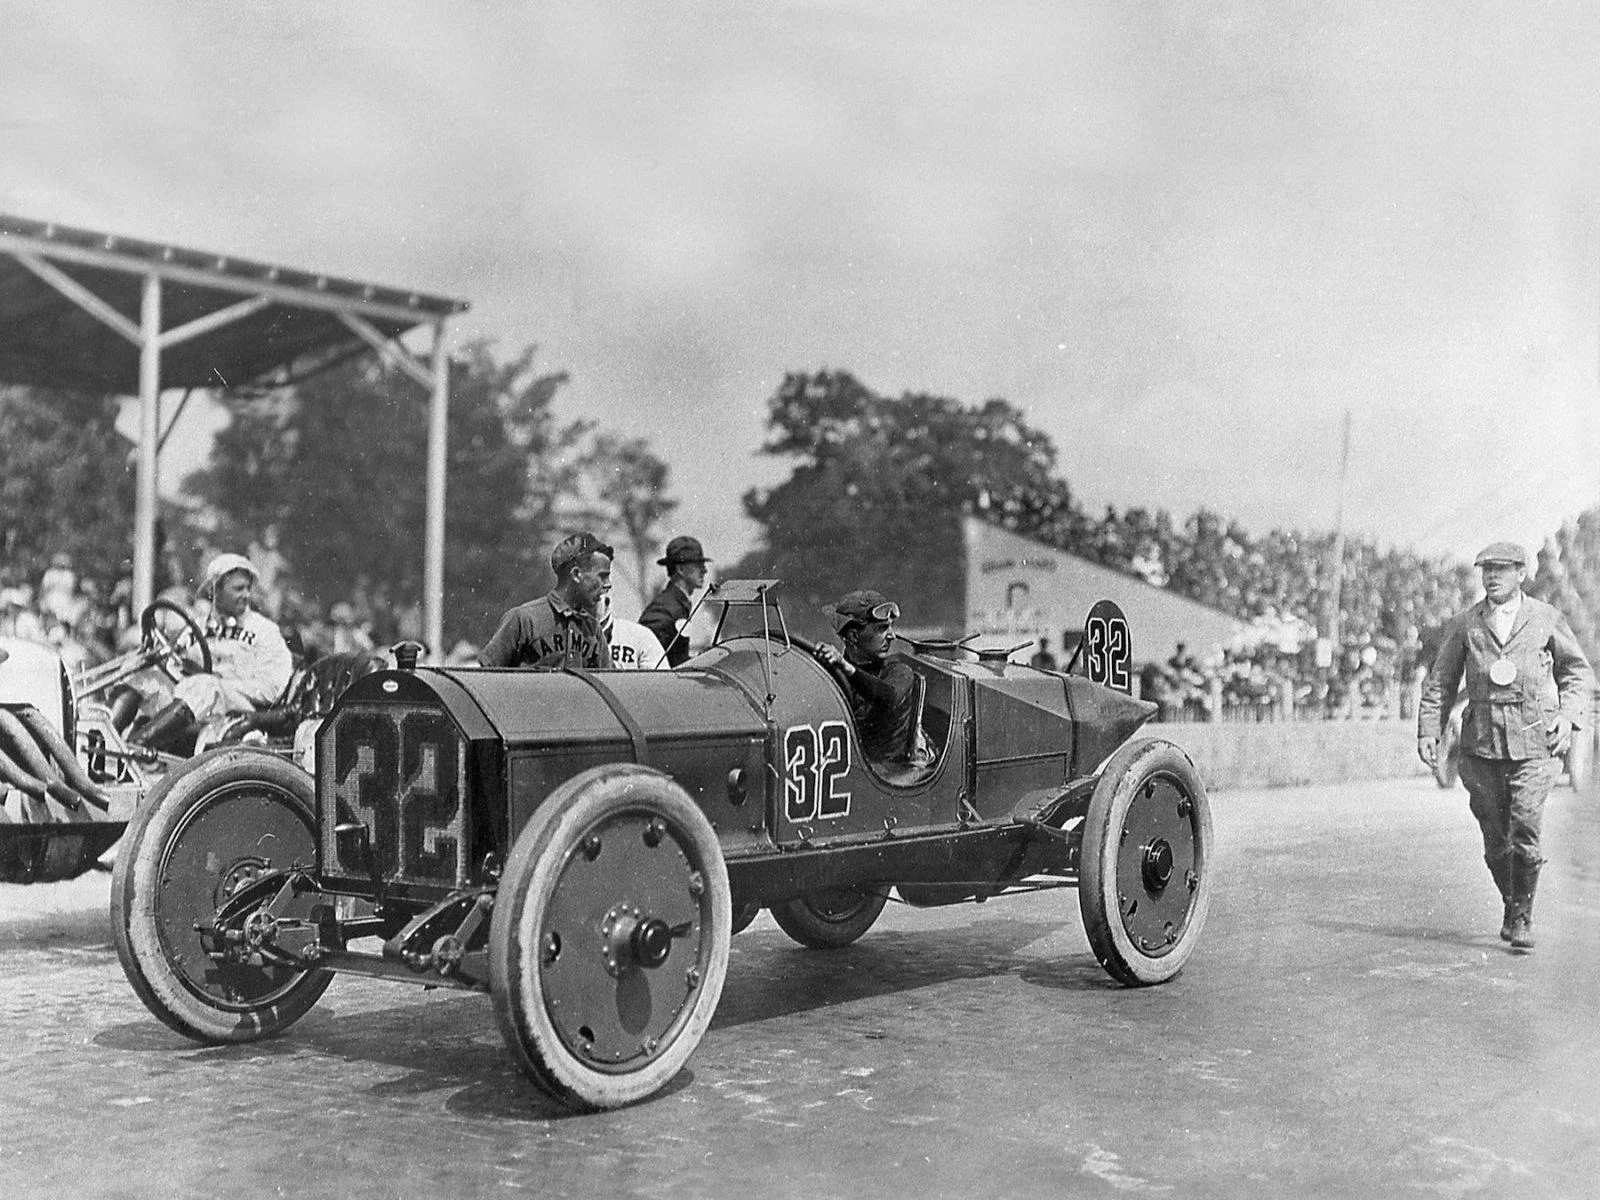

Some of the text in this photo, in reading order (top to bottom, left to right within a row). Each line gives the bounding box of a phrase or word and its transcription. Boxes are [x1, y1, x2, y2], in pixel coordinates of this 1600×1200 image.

[1088, 617, 1129, 689] 32
[335, 713, 461, 886] 32
[784, 720, 851, 823] 32
